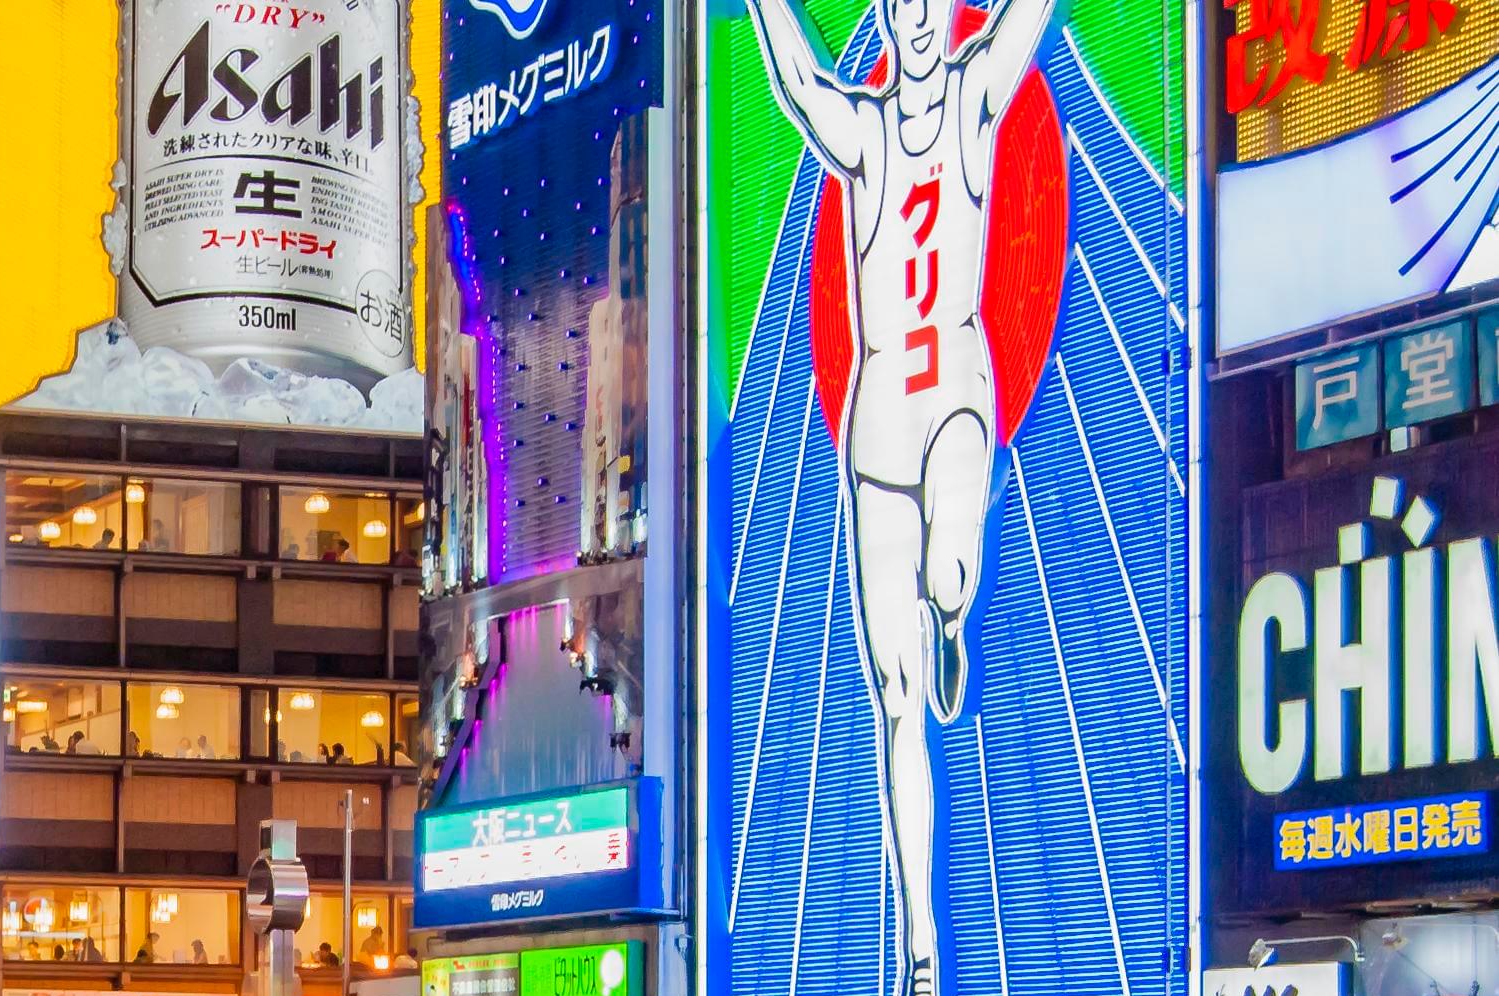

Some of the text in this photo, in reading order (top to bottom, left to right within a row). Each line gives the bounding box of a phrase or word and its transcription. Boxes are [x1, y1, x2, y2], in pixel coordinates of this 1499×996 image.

[146, 19, 384, 151] Asahi
[447, 23, 611, 150] 雪印メグミルク
[233, 169, 302, 219] 生
[200, 228, 338, 260] スーパードライ
[899, 161, 945, 397] グリコ
[238, 305, 297, 332] 350ml
[359, 289, 404, 346] お酒
[471, 800, 573, 848] 大阪ニュース
[1279, 800, 1483, 863] 毎週水曜日発売
